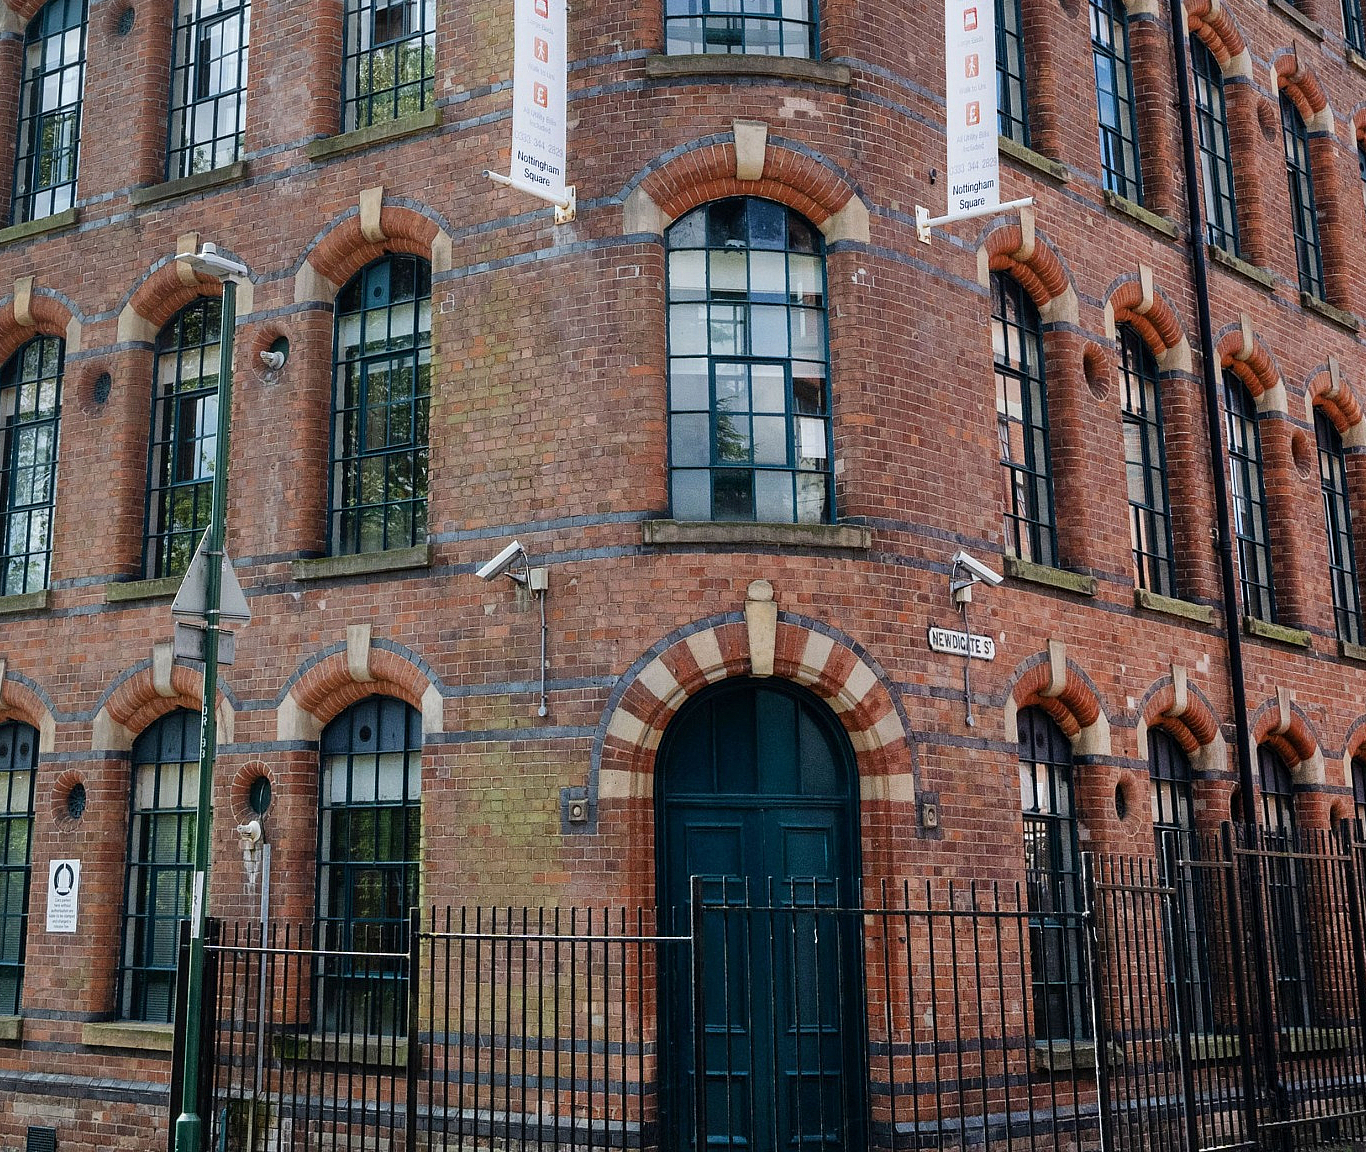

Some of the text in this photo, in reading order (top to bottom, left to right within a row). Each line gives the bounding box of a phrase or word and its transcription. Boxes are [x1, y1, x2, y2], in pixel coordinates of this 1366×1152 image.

[517, 150, 560, 176] Nottingham
[524, 167, 551, 187] Square
[952, 179, 994, 196] Nottingham
[959, 197, 985, 210] Square
